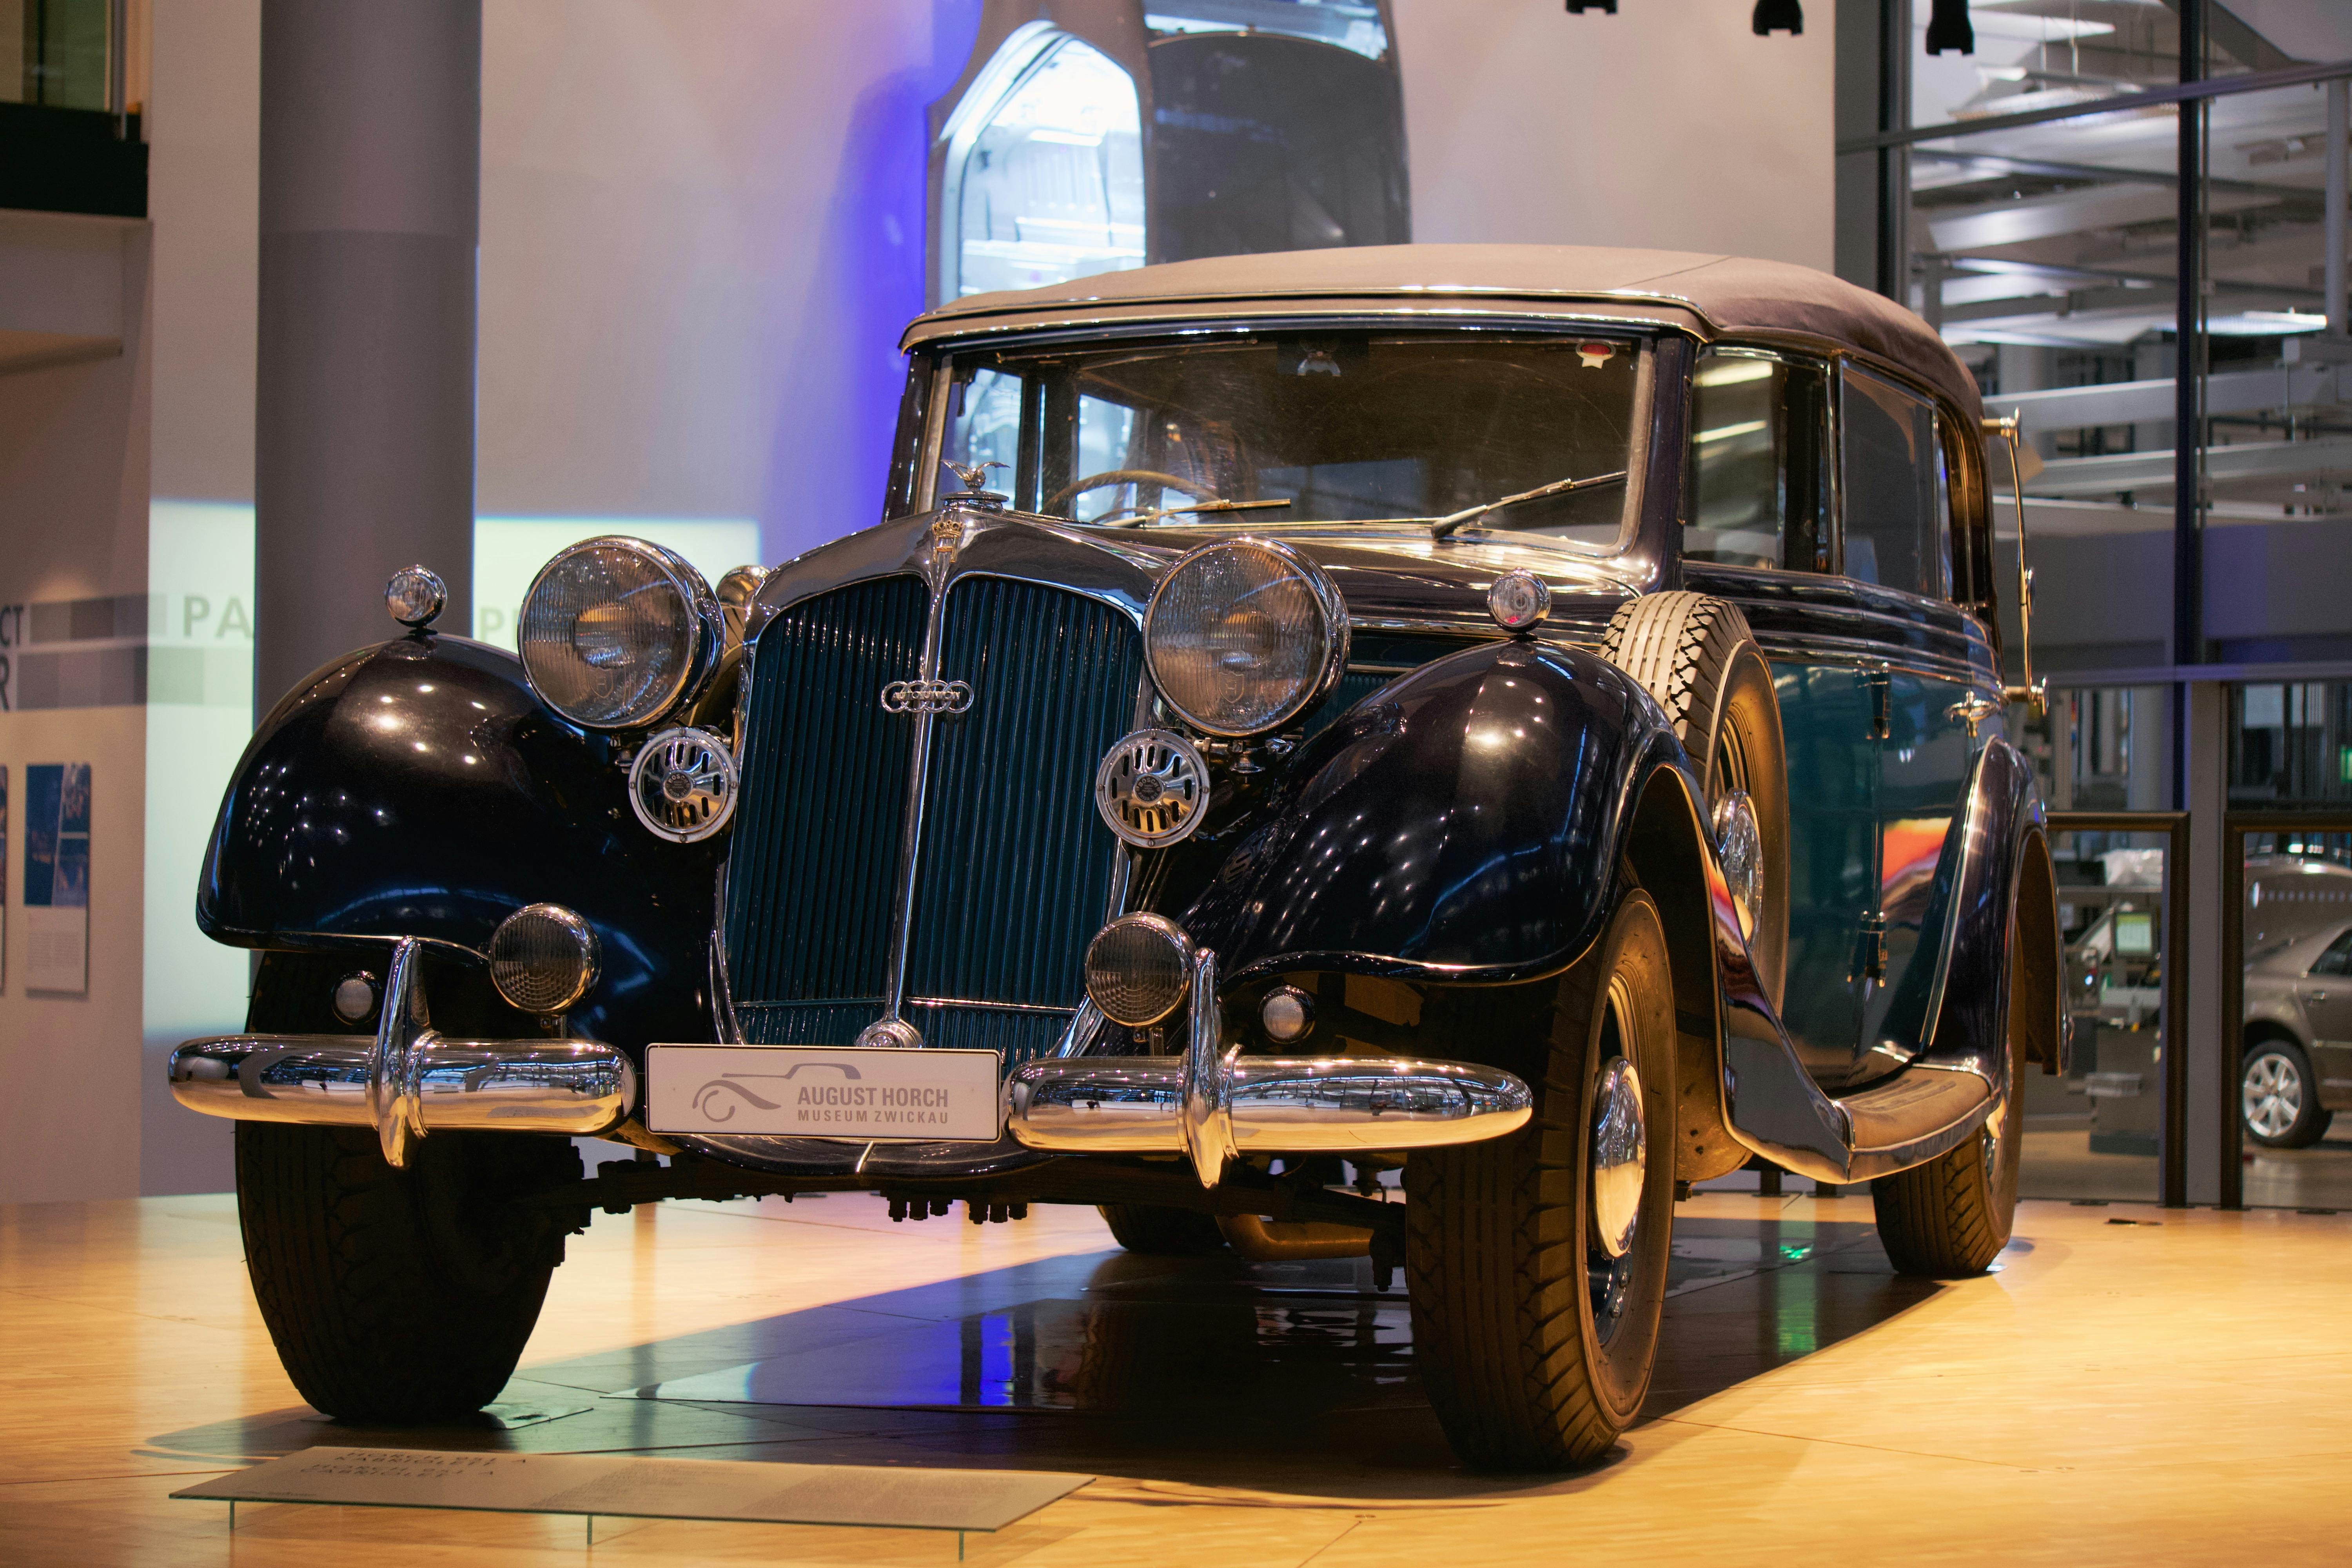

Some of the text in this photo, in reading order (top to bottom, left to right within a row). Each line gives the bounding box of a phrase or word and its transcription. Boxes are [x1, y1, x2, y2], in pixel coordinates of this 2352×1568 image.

[797, 1087, 948, 1107] AUGUST HORCH
[798, 1109, 948, 1124] MUSEUM ZWICKAU
